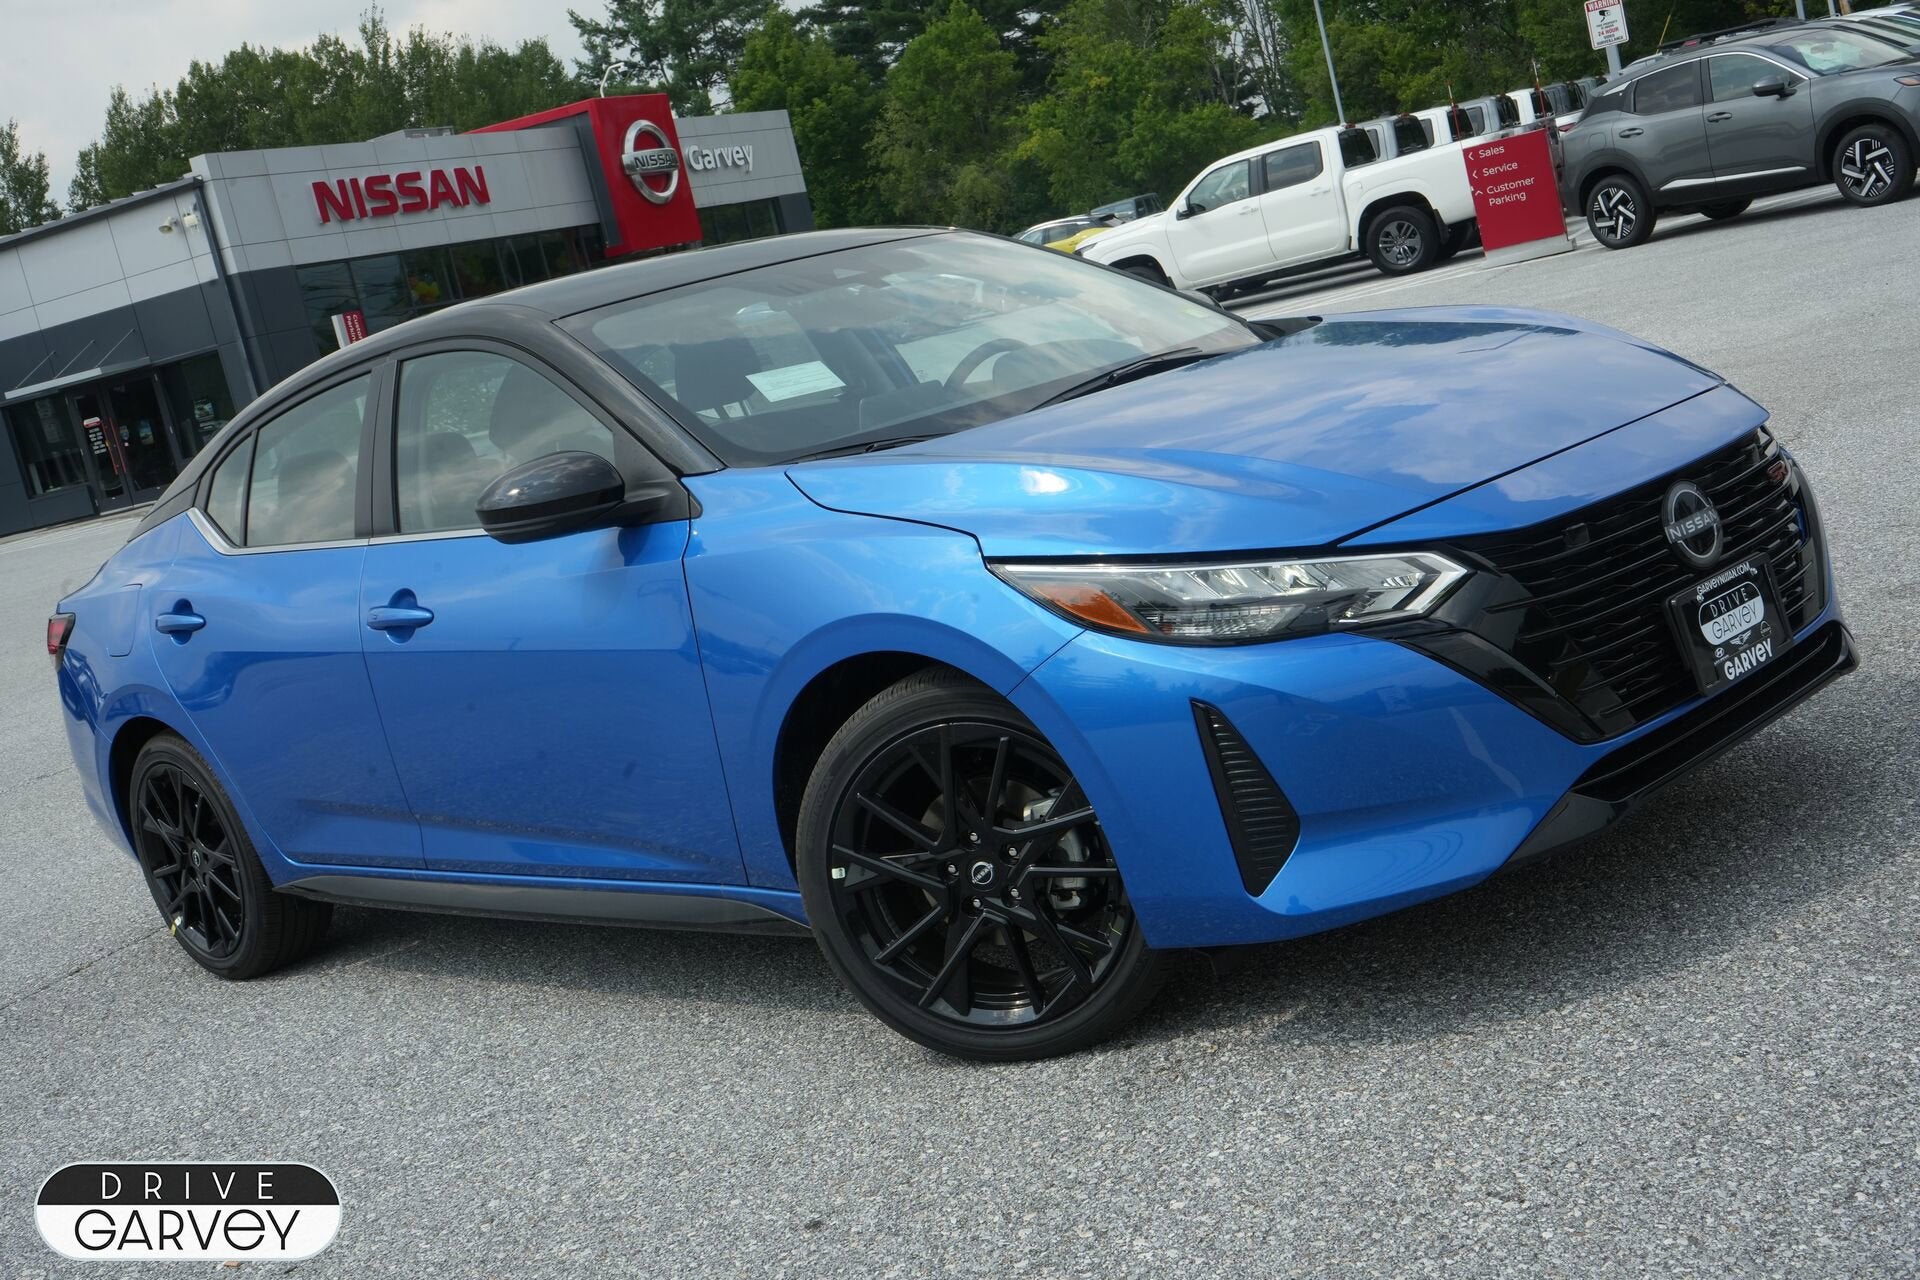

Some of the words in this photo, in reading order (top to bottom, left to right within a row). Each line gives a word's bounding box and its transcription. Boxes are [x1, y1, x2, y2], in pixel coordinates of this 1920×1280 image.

[1588, 0, 1619, 11] WARNING
[1605, 27, 1619, 35] HOUR
[686, 145, 753, 173] Garvey
[1478, 145, 1505, 158] Sales
[1482, 162, 1518, 177] Service
[1486, 177, 1535, 194] Customer
[311, 165, 491, 224] NISSAN
[1488, 191, 1527, 206] Parking
[1669, 510, 1717, 540] NISSAN
[1709, 588, 1749, 618] DRIVE
